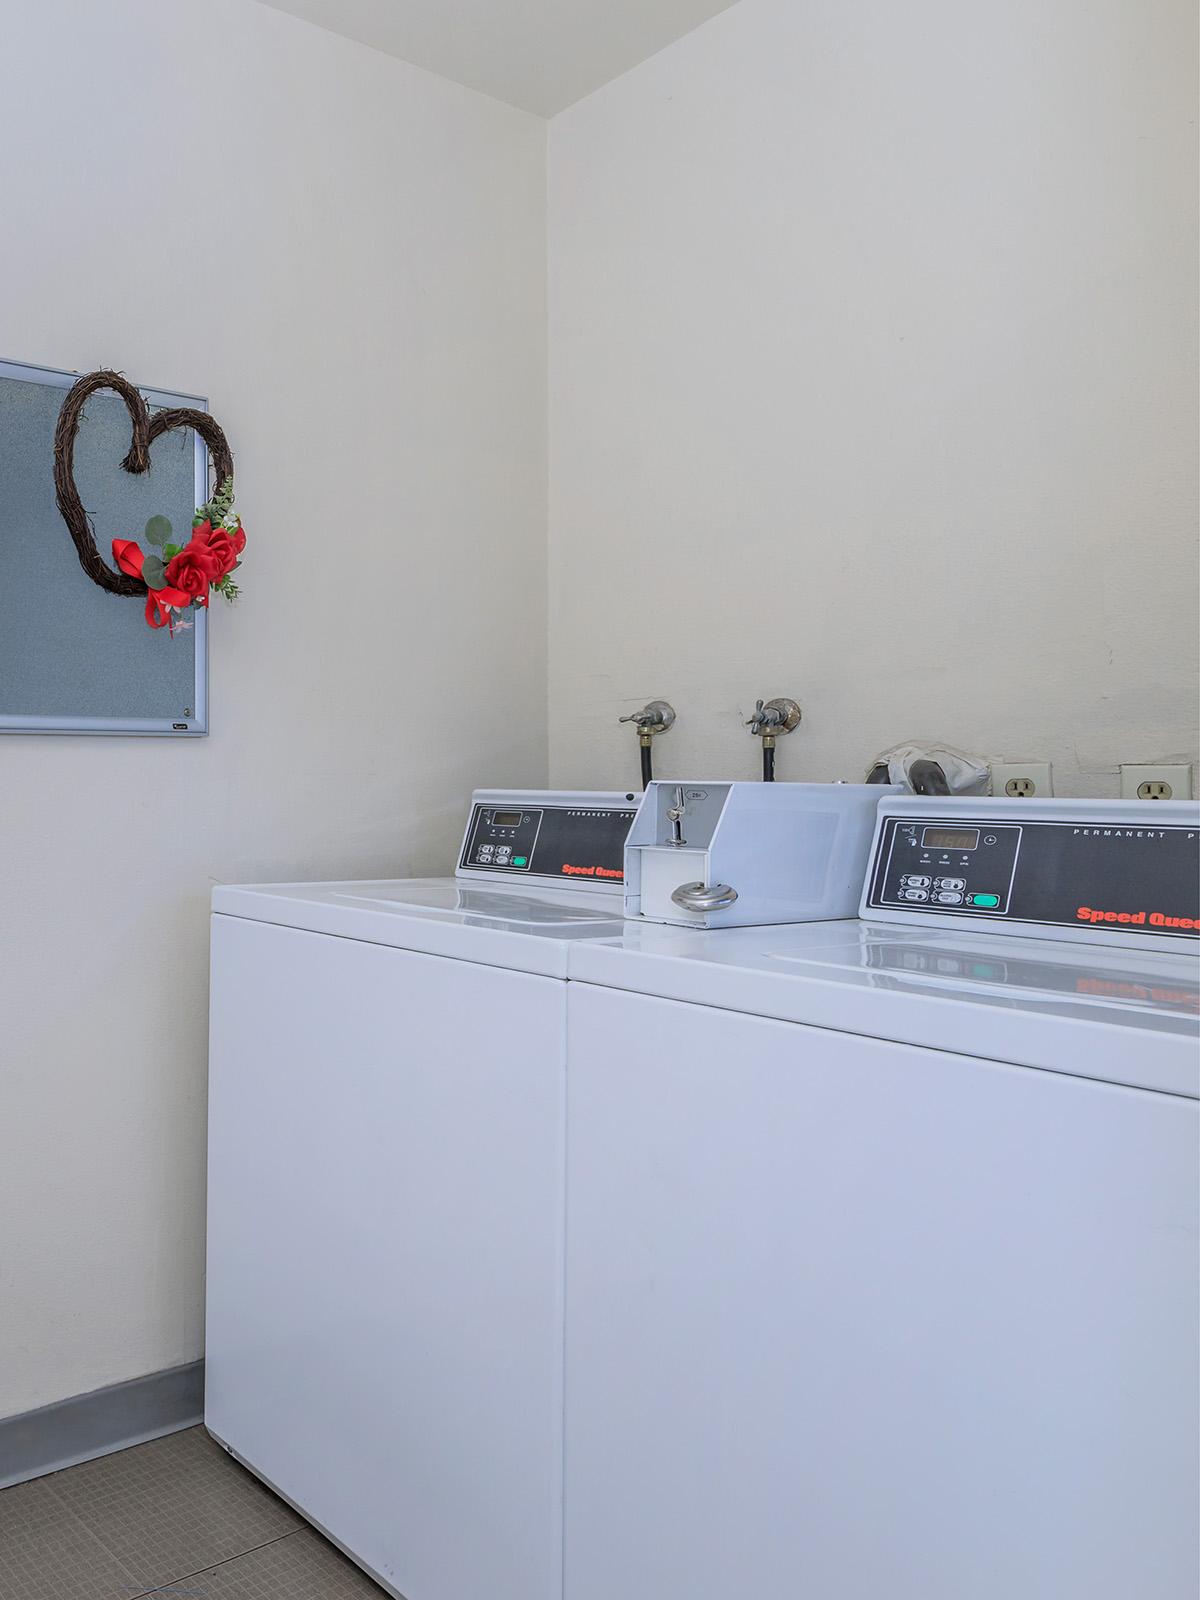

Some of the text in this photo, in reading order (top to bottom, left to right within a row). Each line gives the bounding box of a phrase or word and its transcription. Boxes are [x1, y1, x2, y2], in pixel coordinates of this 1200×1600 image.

[1073, 829, 1165, 838] PERMANENT
[562, 864, 624, 878] Speed Quee
[1077, 906, 1146, 923] Speed
